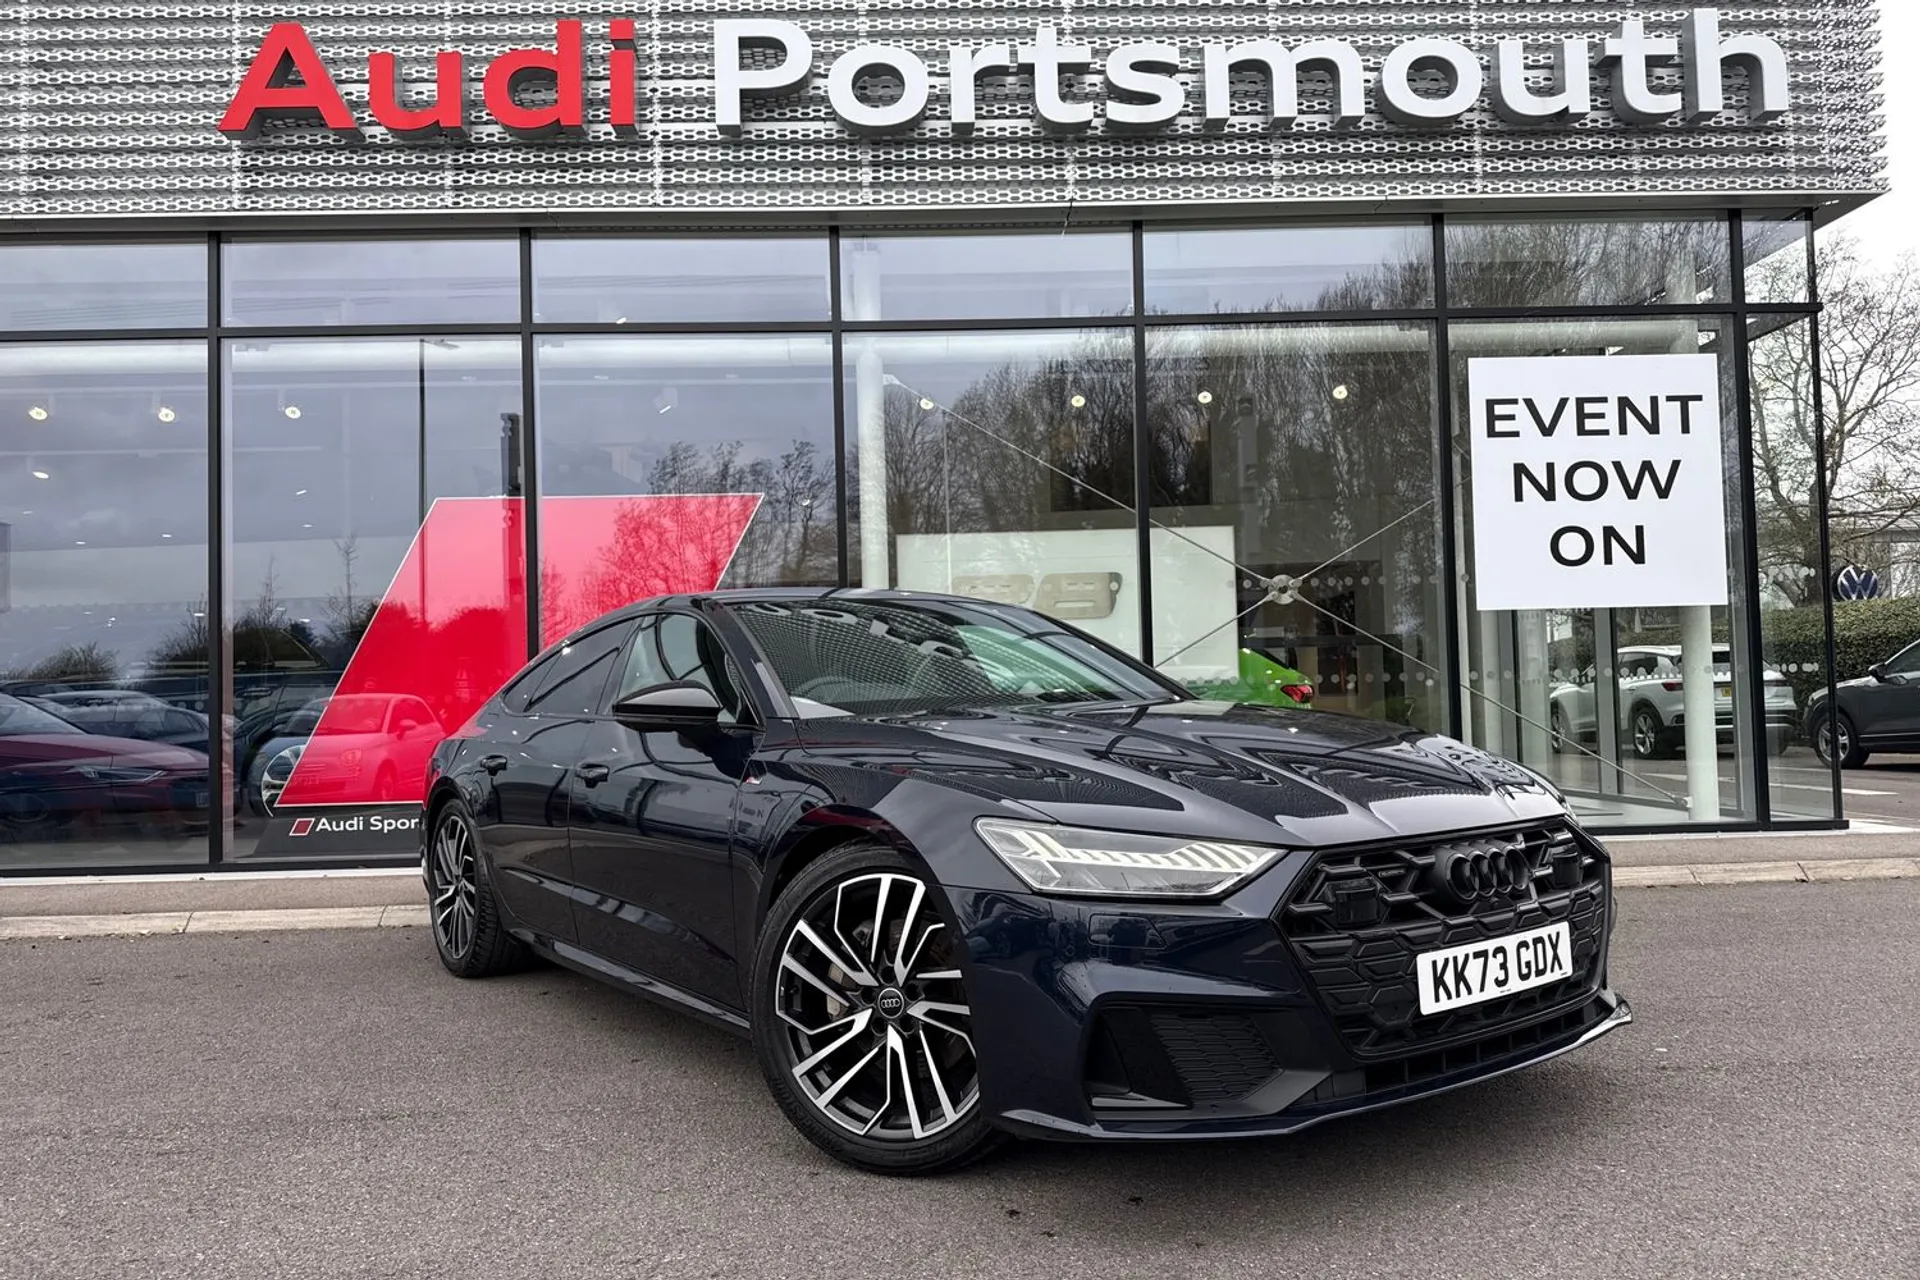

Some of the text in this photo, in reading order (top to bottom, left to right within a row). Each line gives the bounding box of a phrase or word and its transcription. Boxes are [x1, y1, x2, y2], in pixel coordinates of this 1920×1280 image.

[219, 8, 1791, 132] Audi Portsmouth
[1485, 394, 1703, 438] EVENT
[1513, 459, 1682, 503] NOW
[1549, 524, 1646, 567] ON
[315, 815, 421, 834] Audi Spor
[1431, 931, 1563, 1003] KK73 GDX
